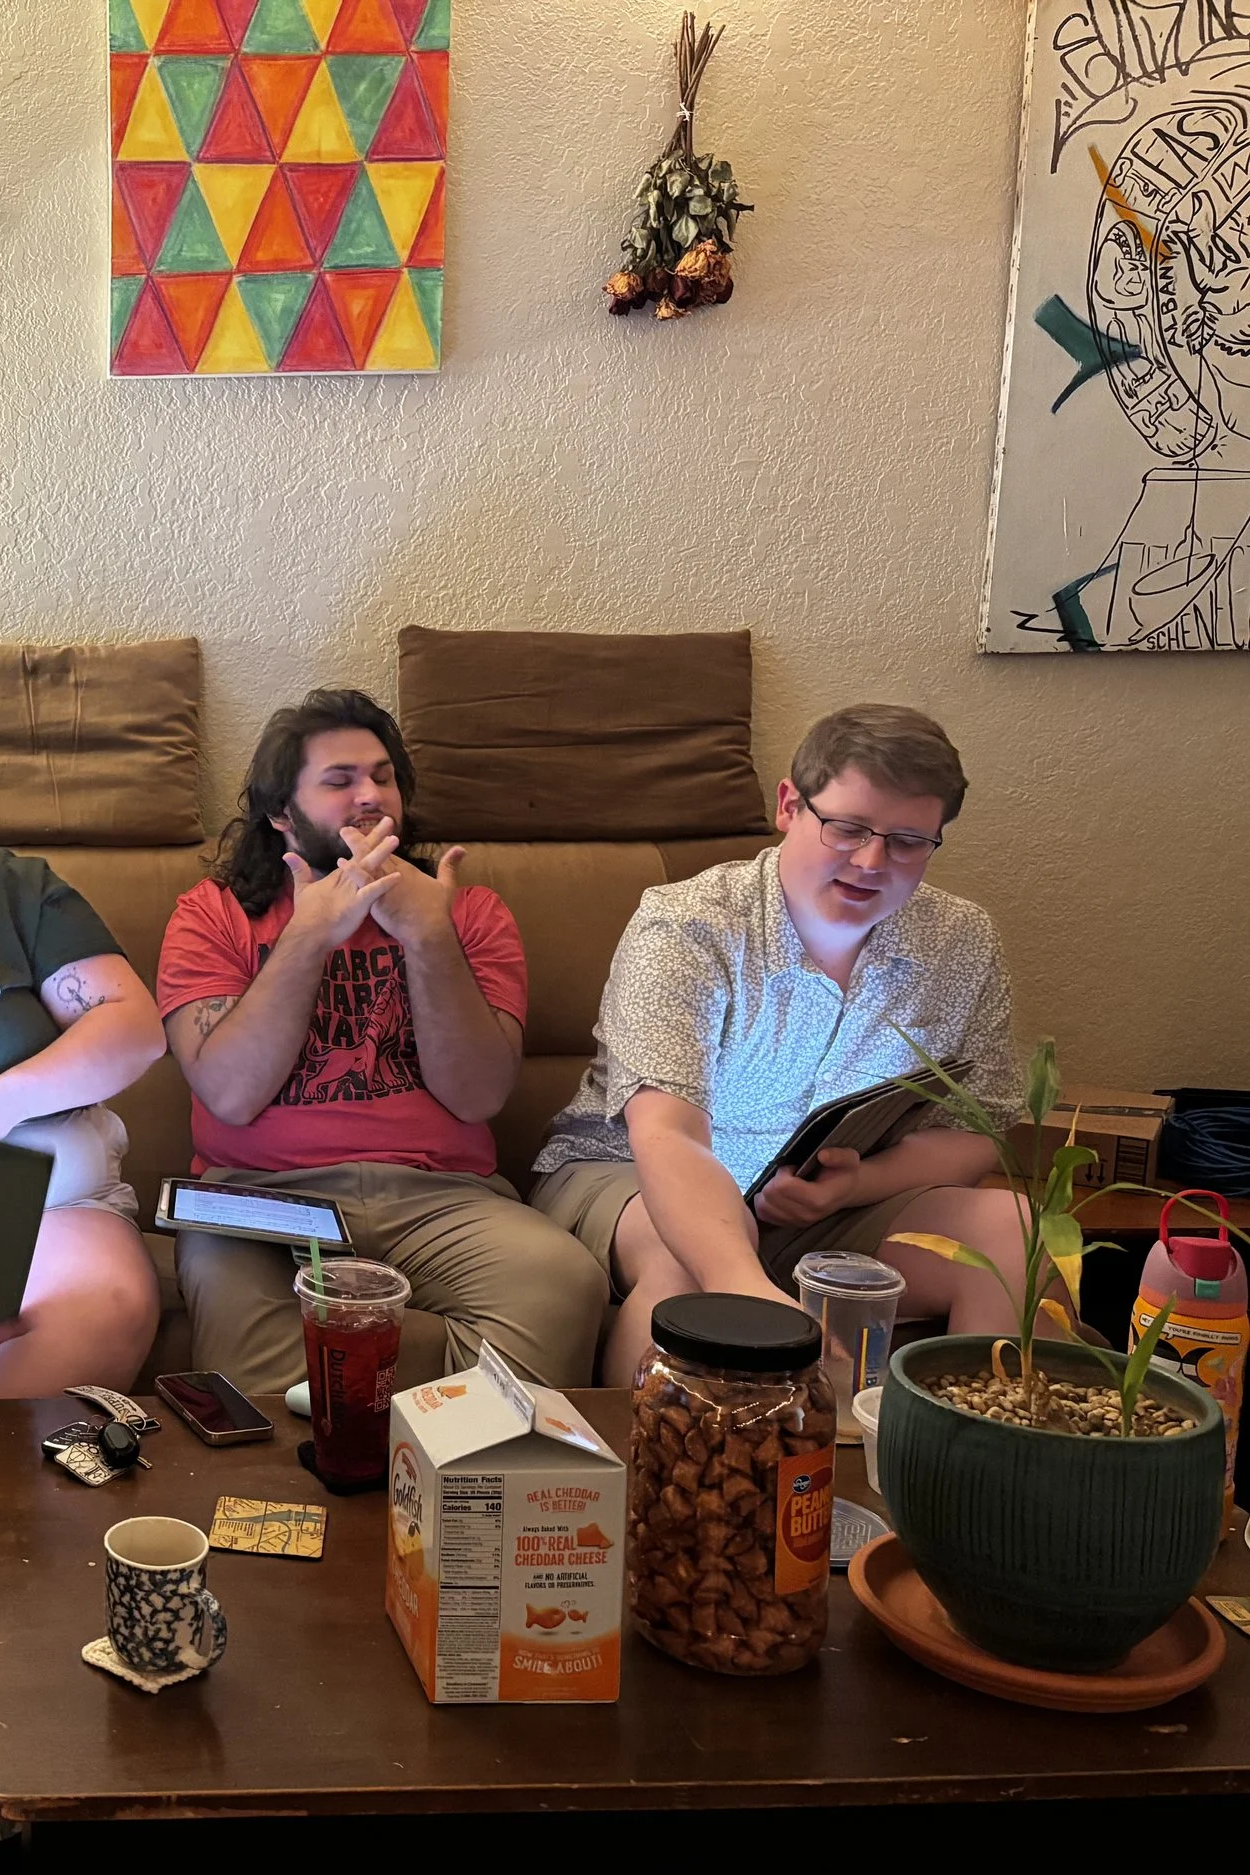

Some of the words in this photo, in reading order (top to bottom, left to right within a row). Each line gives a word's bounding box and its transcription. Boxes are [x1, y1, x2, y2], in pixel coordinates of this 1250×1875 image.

[1146, 546, 1250, 650] SCHENEC
[443, 1476, 478, 1484] Nutrition
[481, 1476, 502, 1484] Facts
[393, 1472, 423, 1523] Goldfish
[526, 1488, 553, 1503] REAL
[555, 1487, 600, 1503] CHEDDAR
[485, 1502, 502, 1511] 140
[540, 1502, 550, 1512] IS
[523, 1525, 540, 1533] Always
[548, 1535, 577, 1552] REAL
[515, 1553, 565, 1566] CHEDDAR
[568, 1551, 607, 1566] CHEESE
[556, 1572, 588, 1581] ARTIFICIAL
[512, 1655, 552, 1674] SMILE
[556, 1654, 603, 1674] ABOUT!
